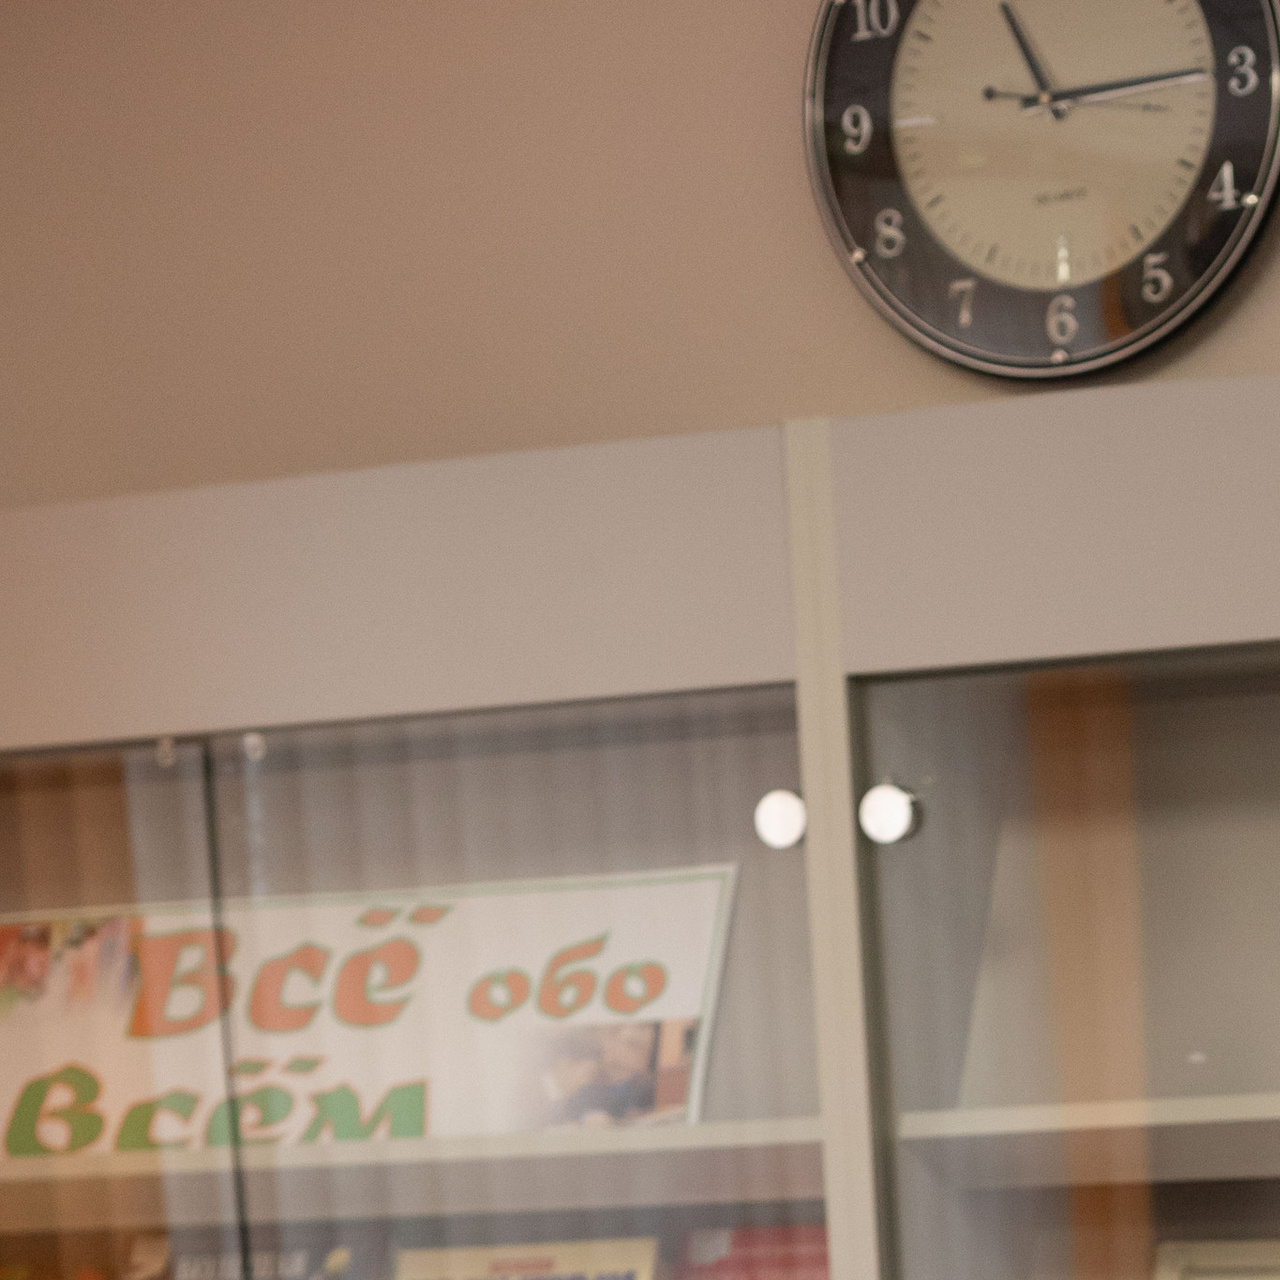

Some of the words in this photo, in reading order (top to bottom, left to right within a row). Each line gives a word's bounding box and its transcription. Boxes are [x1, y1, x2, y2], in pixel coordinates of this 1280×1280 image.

[851, 0, 897, 42] 10
[1227, 46, 1259, 96] 3
[841, 104, 873, 154] 9
[1207, 161, 1242, 211] 4
[874, 208, 906, 258] 8
[1141, 252, 1174, 303] 5
[948, 279, 976, 328] 7
[1046, 295, 1079, 346] 6
[126, 904, 453, 1041] Всё
[466, 932, 667, 1023] обо
